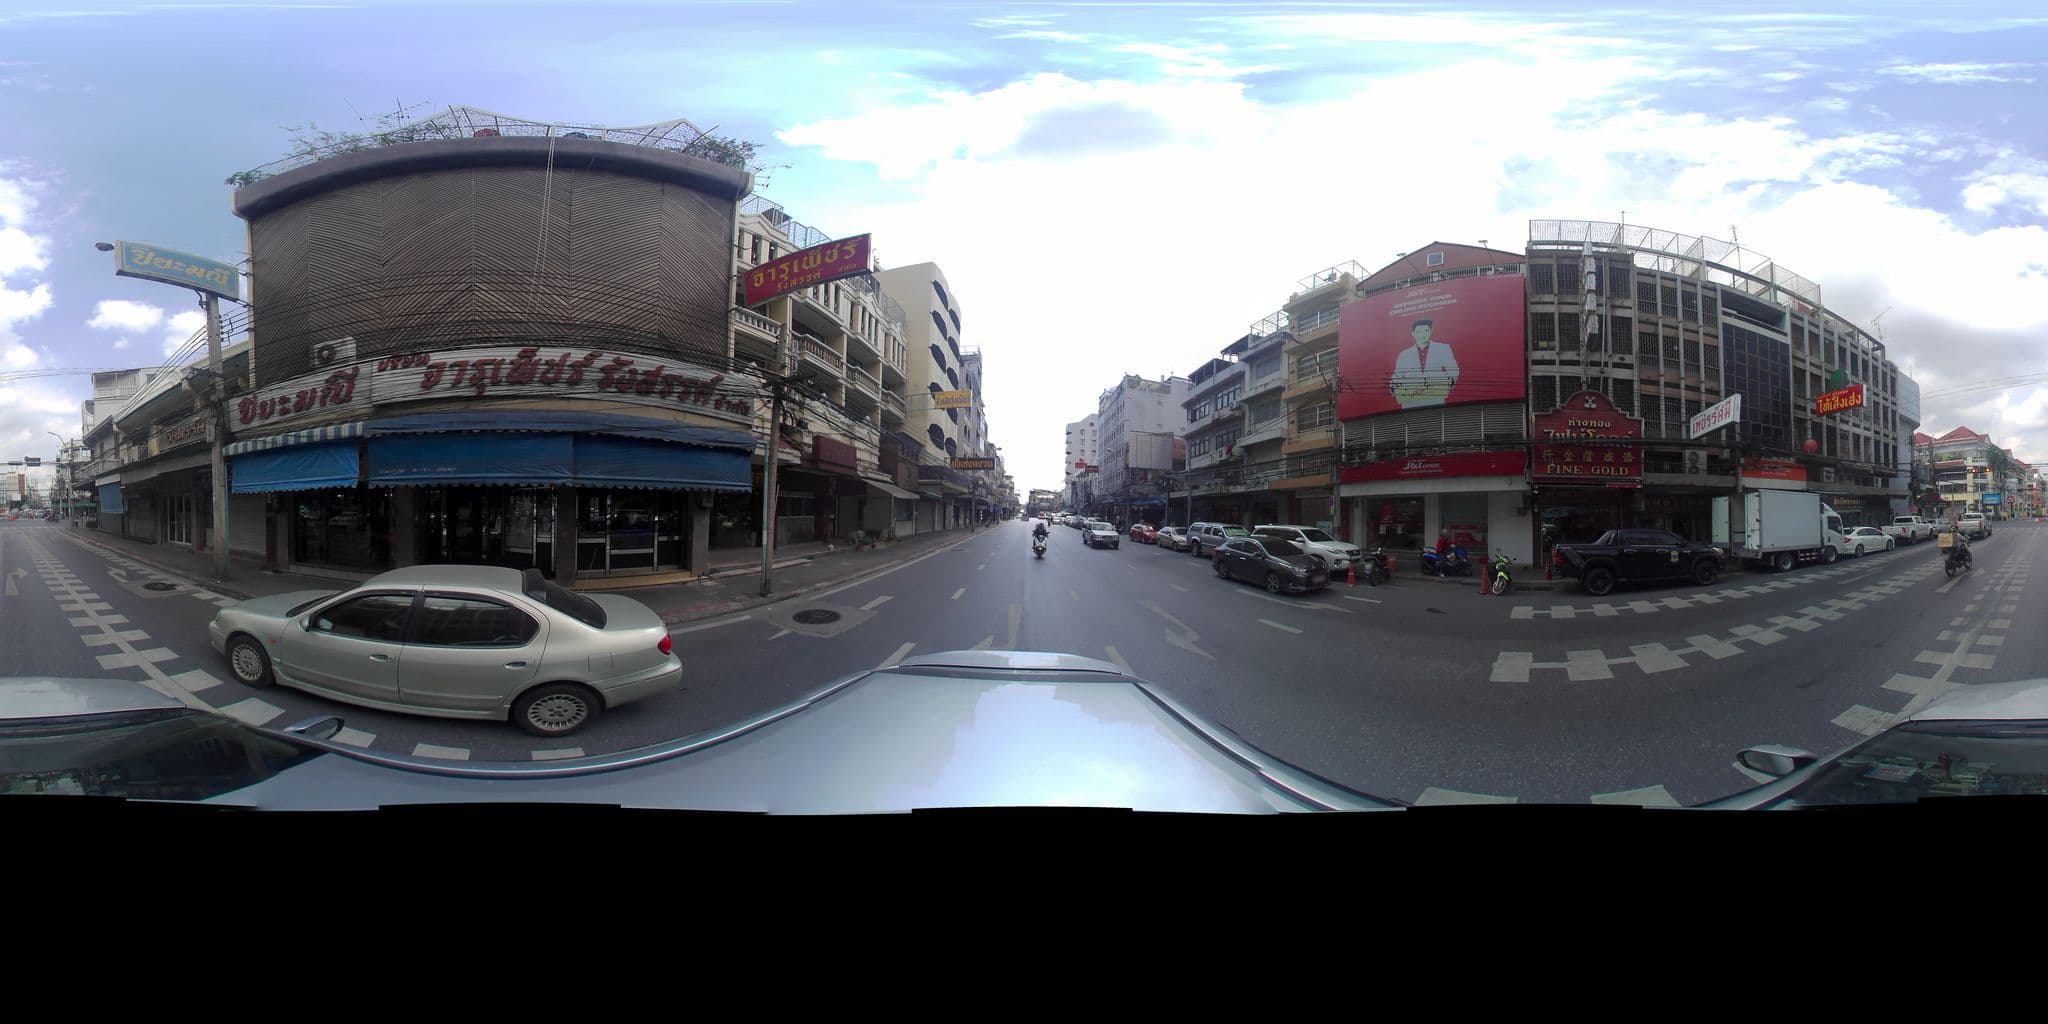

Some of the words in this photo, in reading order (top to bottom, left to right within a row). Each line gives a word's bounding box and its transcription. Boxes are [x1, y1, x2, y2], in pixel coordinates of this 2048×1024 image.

[1430, 293, 1452, 301] YOUR
[238, 366, 359, 425] ปิยะมณี
[1568, 416, 1611, 428] ห้างทอง
[1547, 464, 1583, 475] FINE
[1591, 466, 1629, 476] GOLD
